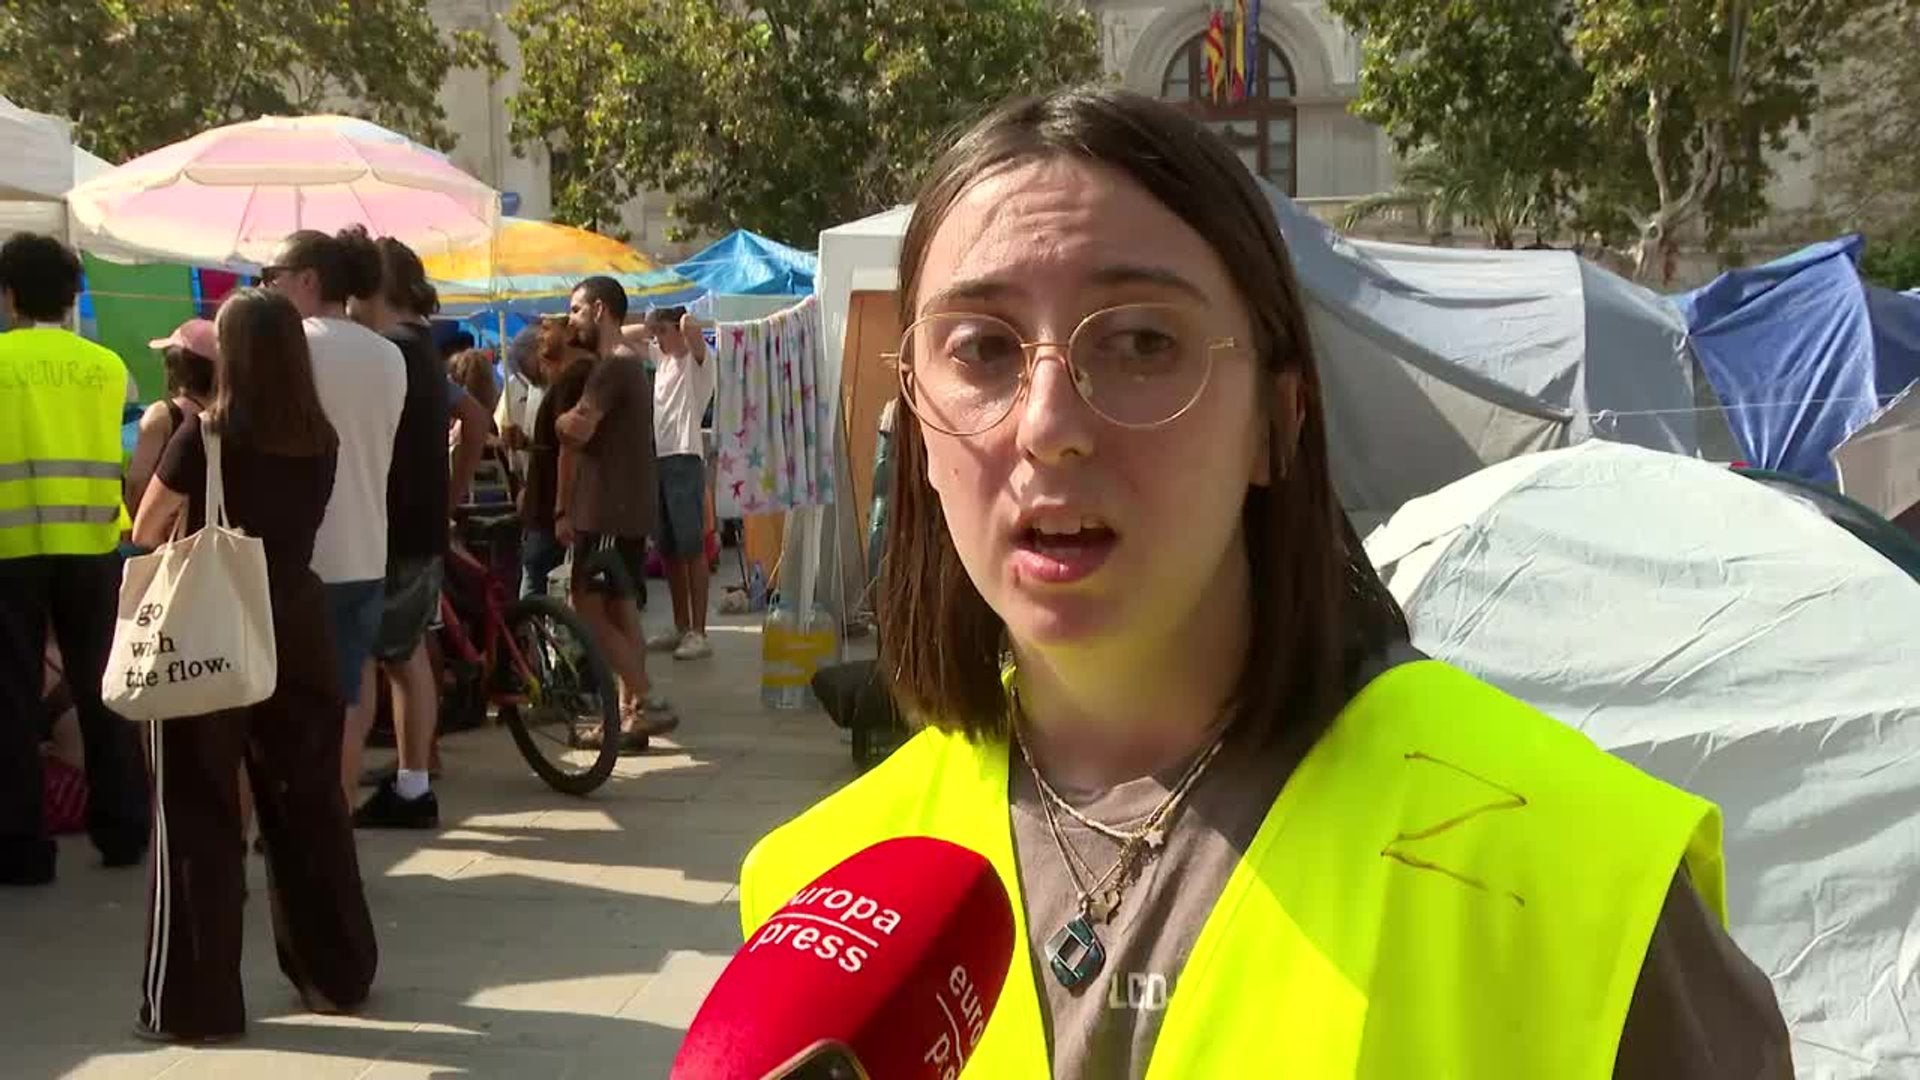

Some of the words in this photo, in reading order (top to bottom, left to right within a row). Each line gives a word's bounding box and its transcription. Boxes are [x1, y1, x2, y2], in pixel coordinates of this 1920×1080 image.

[136, 602, 164, 626] go
[131, 631, 176, 658] wih
[125, 667, 159, 688] the
[167, 657, 231, 683] flow.
[789, 887, 902, 935] uropa
[749, 922, 868, 972] press
[949, 965, 984, 1047] euro
